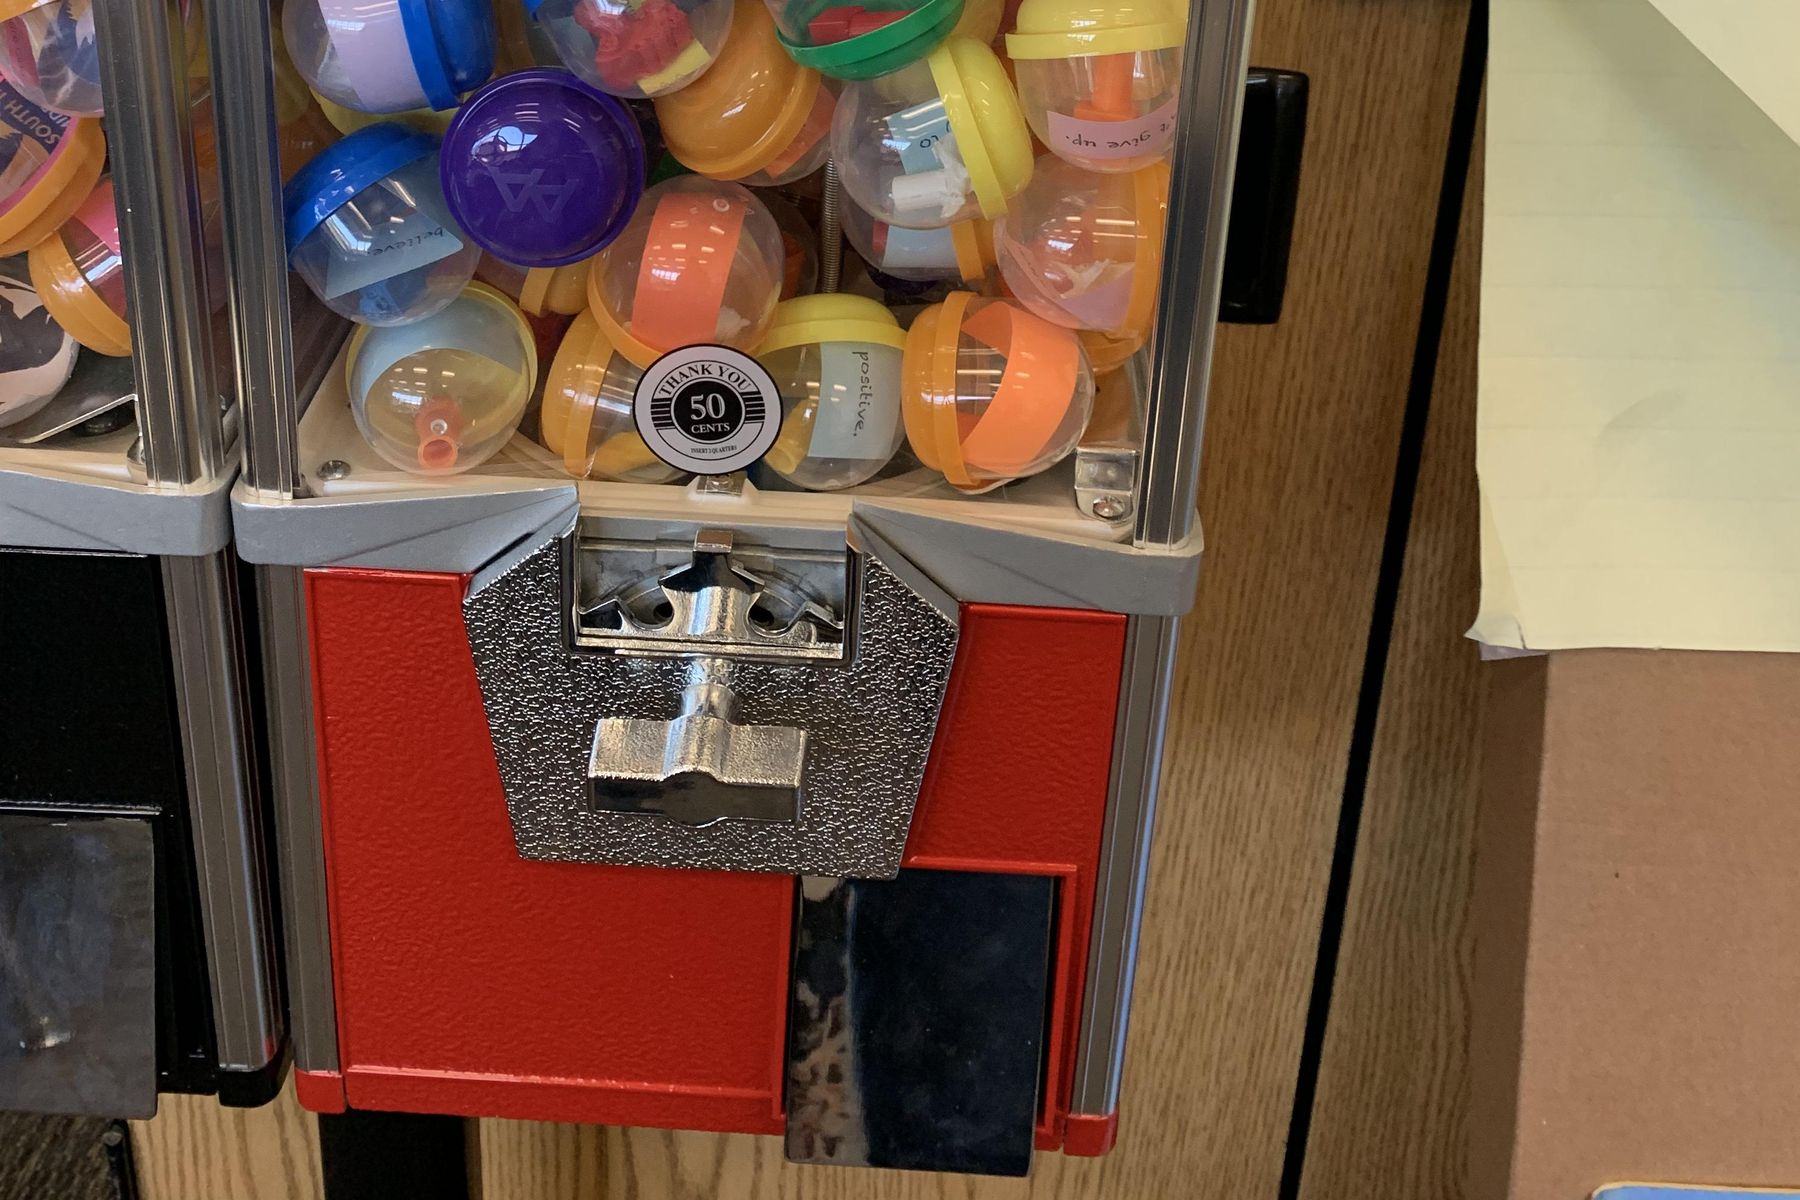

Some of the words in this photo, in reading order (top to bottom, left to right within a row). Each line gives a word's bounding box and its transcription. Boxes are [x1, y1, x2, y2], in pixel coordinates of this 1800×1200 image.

[5, 99, 61, 145] SOUTH
[658, 363, 713, 396] THANK
[718, 365, 752, 391] YOU
[852, 351, 873, 437] positive.
[690, 392, 726, 420] 50
[691, 422, 730, 434] CENTS
